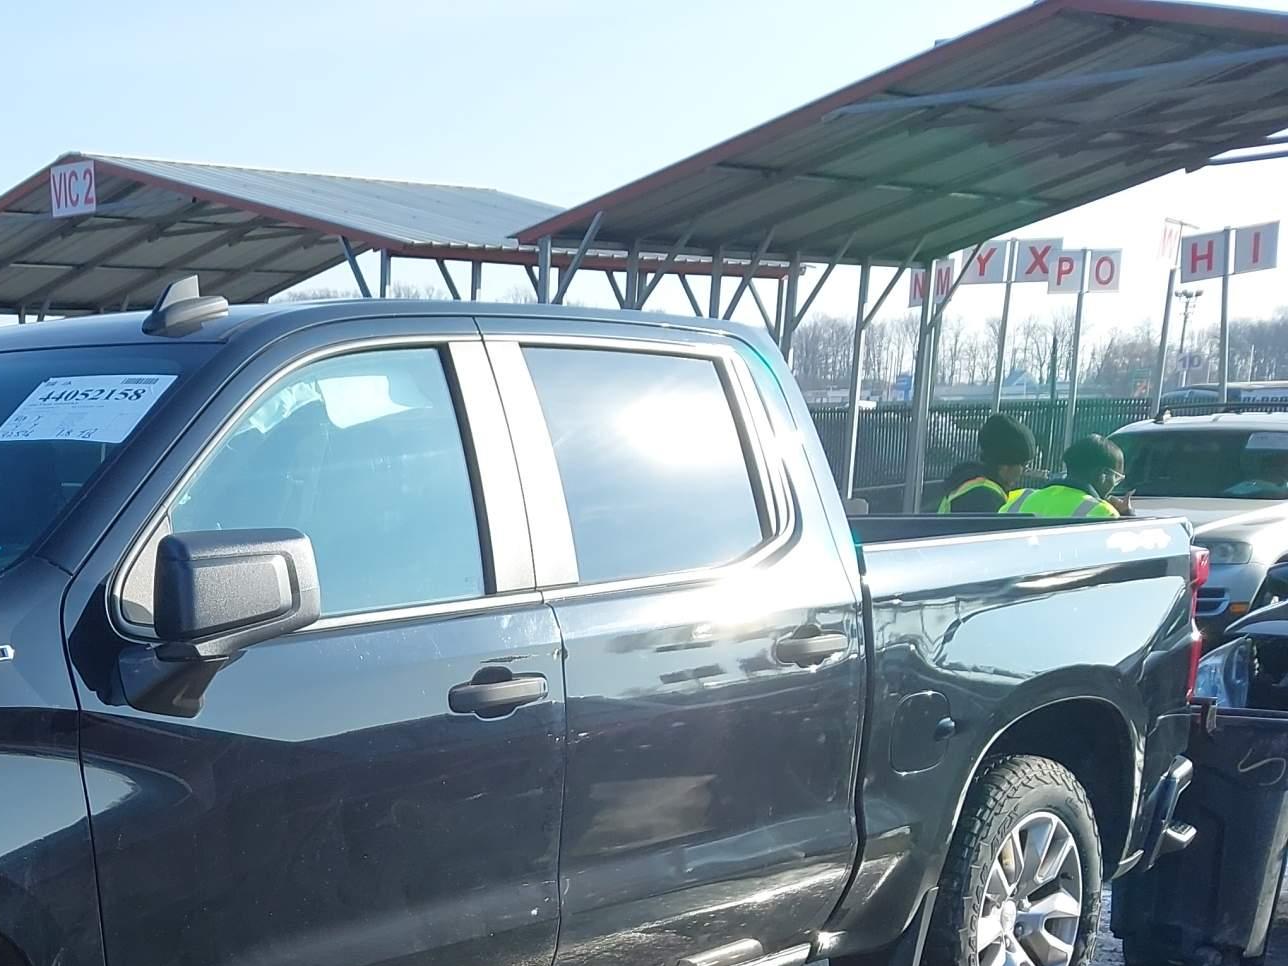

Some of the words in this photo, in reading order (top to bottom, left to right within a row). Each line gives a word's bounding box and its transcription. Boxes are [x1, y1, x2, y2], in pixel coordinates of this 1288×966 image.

[52, 170, 80, 209] VIC
[83, 167, 94, 205] 2
[975, 247, 998, 276] Y
[1025, 246, 1052, 275] X
[1191, 240, 1214, 274] H
[1252, 232, 1261, 263] I
[936, 266, 952, 296] M
[1057, 257, 1075, 286] P
[1095, 256, 1116, 285] O
[913, 272, 925, 300] N
[1178, 354, 1203, 369] 10
[38, 388, 146, 402] 44052158
